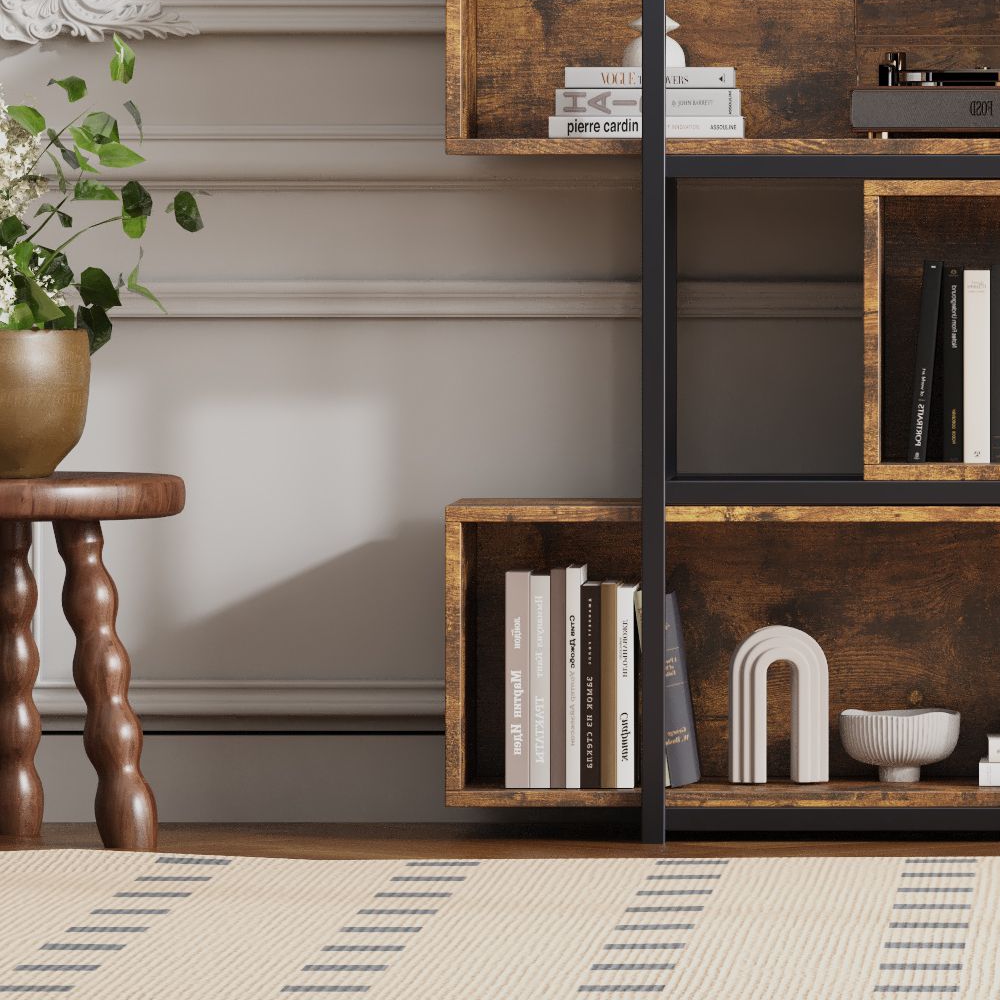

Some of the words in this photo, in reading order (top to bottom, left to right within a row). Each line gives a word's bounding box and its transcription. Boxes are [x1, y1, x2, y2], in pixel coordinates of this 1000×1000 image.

[601, 72, 636, 85] VOGUE
[666, 75, 689, 84] VERS
[563, 91, 642, 115] HAI
[567, 119, 600, 136] pierre
[603, 119, 639, 132] cardin
